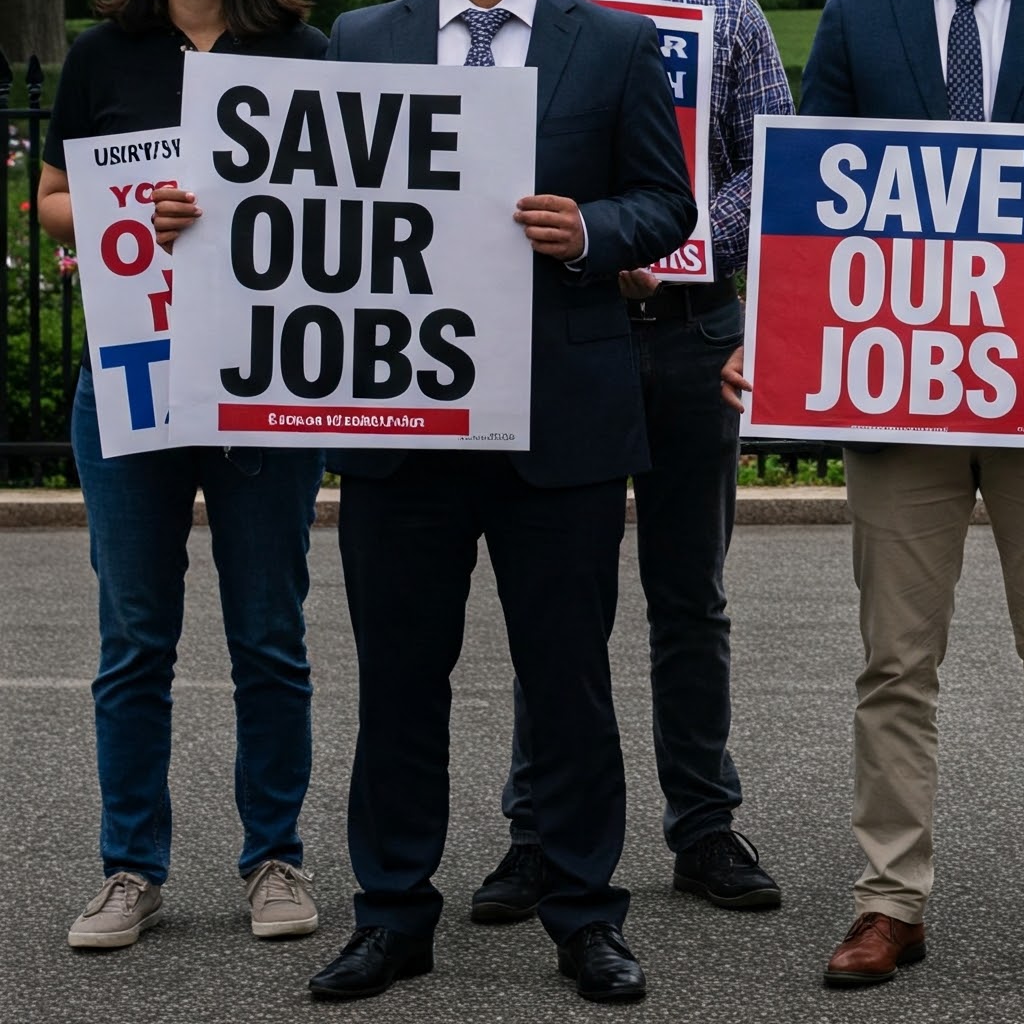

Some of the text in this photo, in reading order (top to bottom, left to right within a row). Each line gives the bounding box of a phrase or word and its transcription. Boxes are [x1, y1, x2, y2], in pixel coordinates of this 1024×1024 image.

[213, 85, 462, 191] SAVE
[109, 180, 178, 208] YO
[816, 143, 1024, 235] SAVE
[231, 195, 434, 295] OUR
[829, 236, 1006, 327] OUR
[220, 305, 476, 401] JOBS
[805, 326, 1018, 419] JOBS
